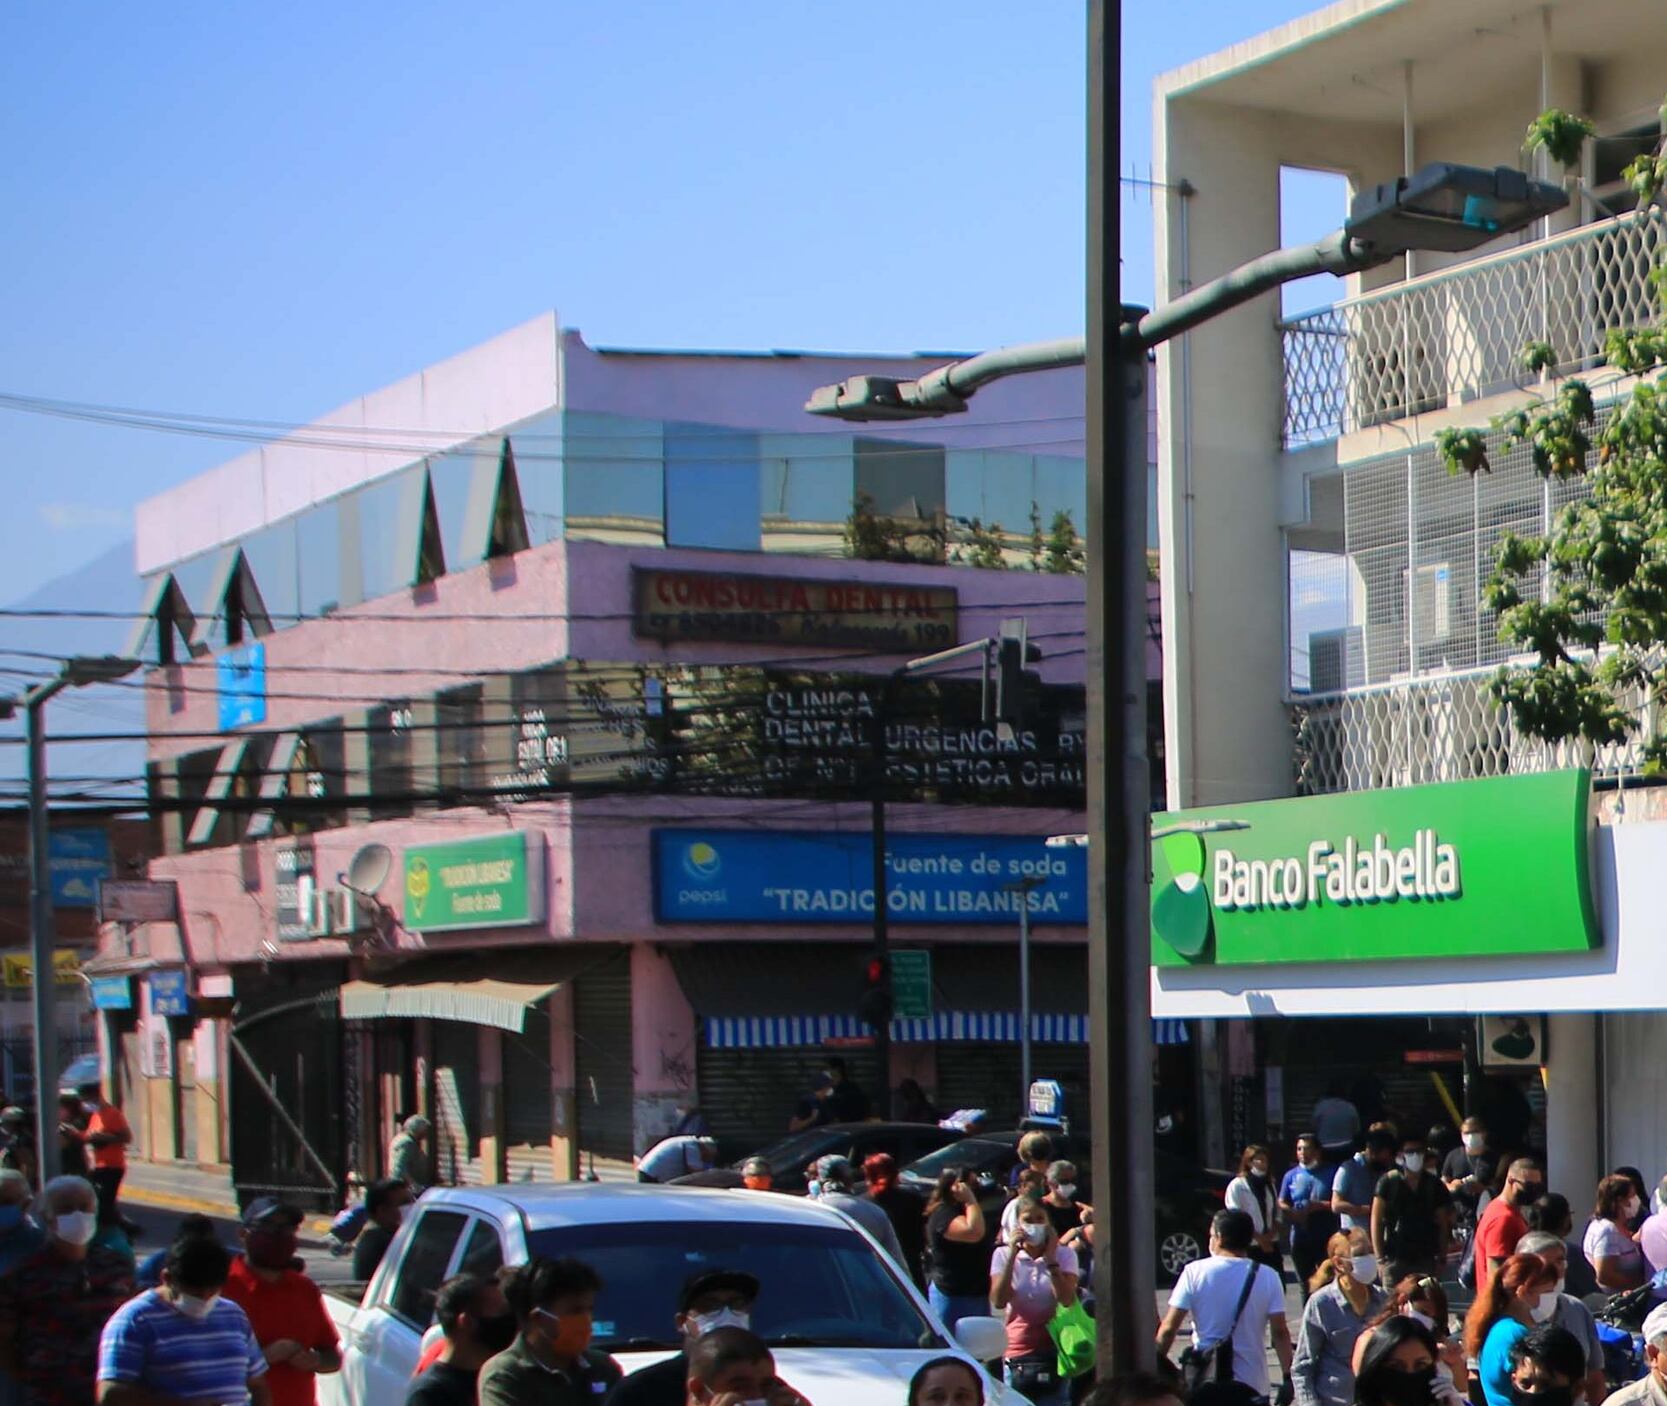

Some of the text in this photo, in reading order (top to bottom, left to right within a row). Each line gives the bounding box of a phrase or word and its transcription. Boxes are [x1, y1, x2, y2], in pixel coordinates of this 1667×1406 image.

[656, 576, 941, 619] CONSULTA DENTAL
[915, 622, 950, 643] 199
[766, 690, 874, 717] CLINICA
[764, 719, 872, 748] DENTAL
[884, 724, 1037, 753] URGENCIAS
[971, 853, 1001, 876] de
[1008, 853, 1068, 876] soda
[1213, 828, 1461, 909] Banco Falabella
[678, 888, 727, 905] pepsi
